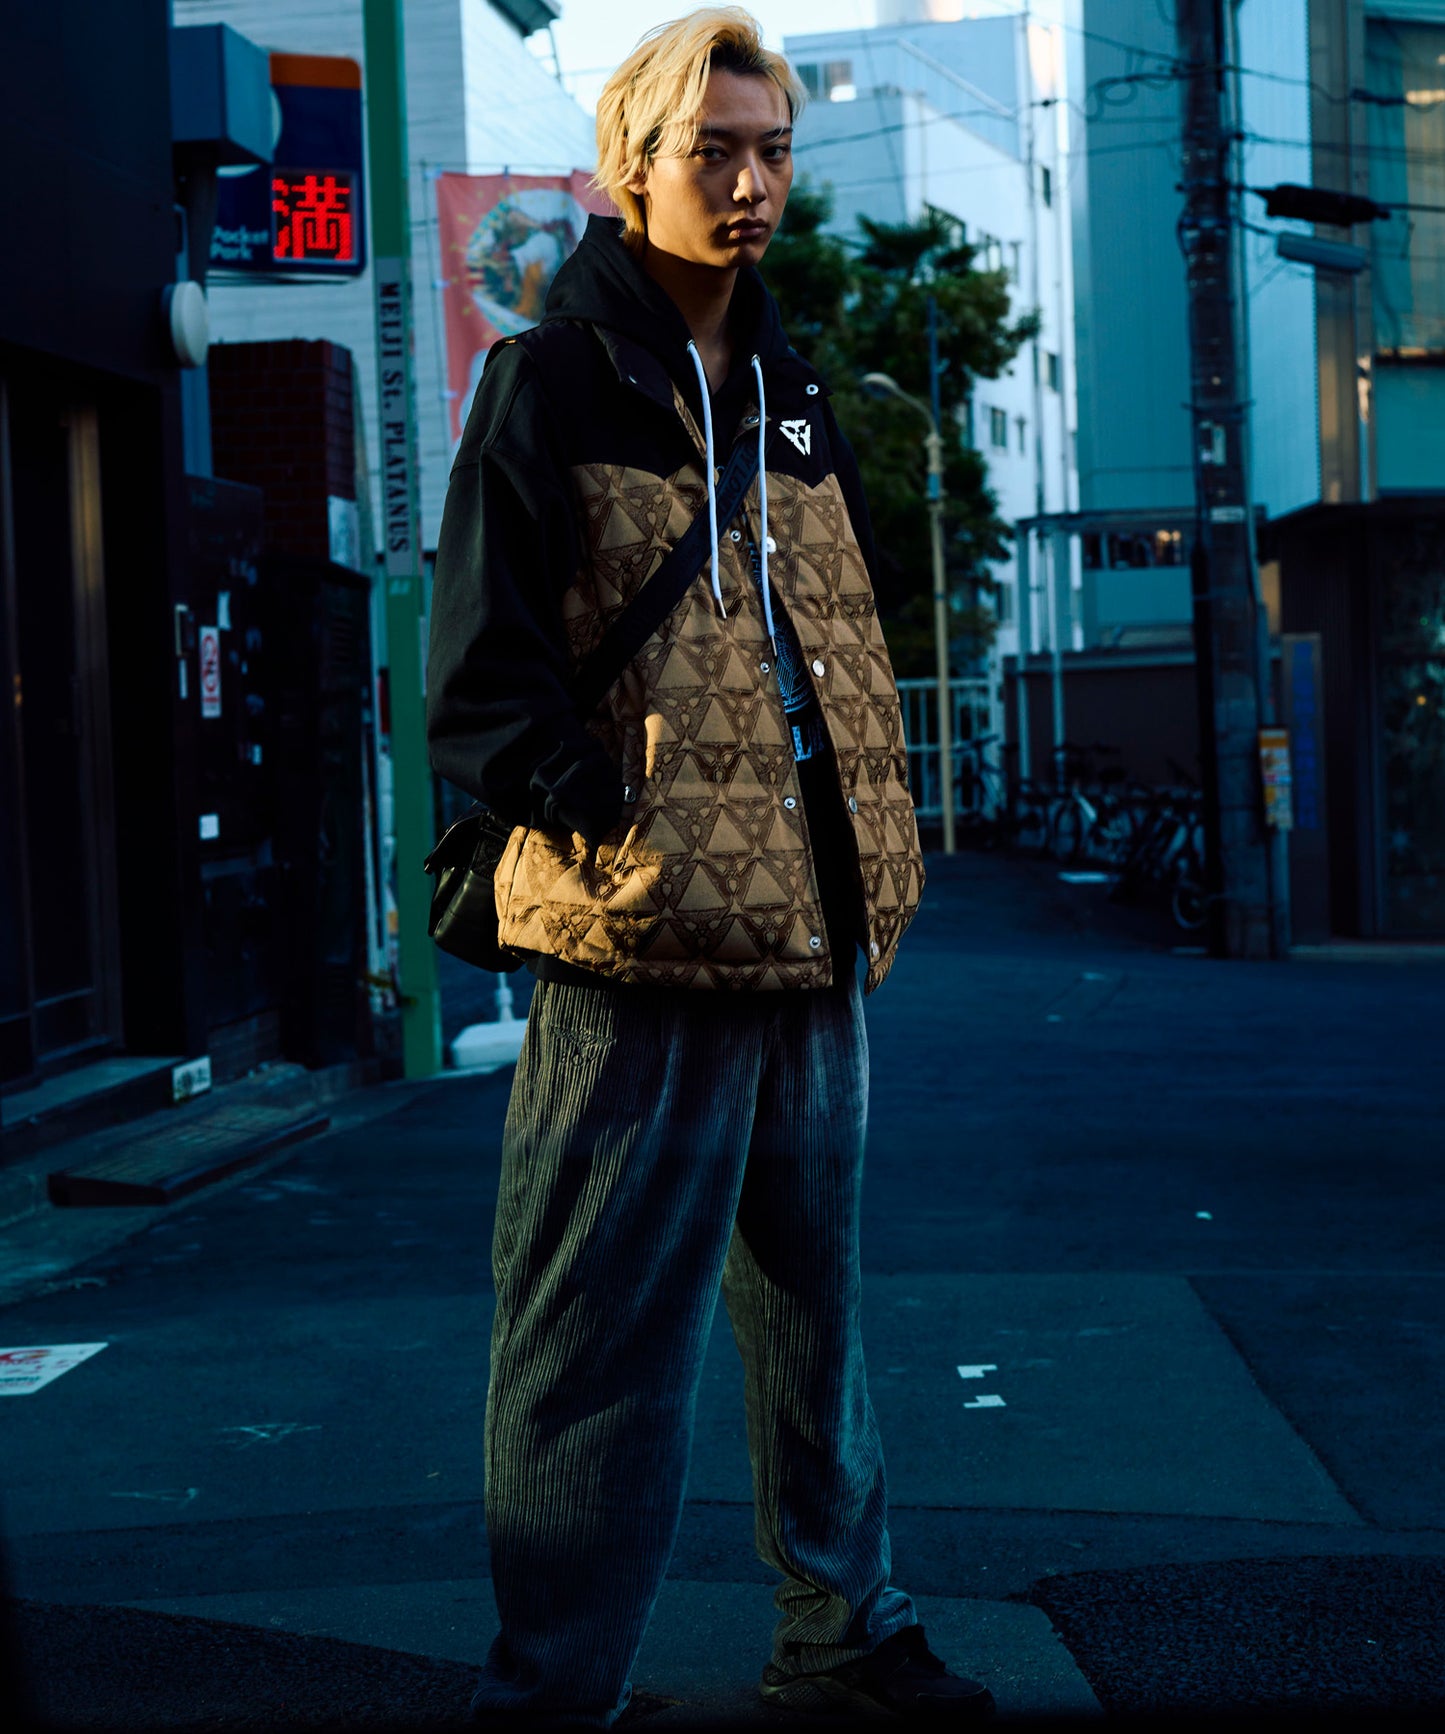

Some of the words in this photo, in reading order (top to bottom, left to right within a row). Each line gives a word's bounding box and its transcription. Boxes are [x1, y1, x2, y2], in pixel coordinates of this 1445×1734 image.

[209, 242, 254, 260] Park
[272, 175, 352, 260] 満
[380, 282, 402, 357] MEIJI
[382, 369, 403, 409] St.
[385, 422, 409, 551] PLATANUS
